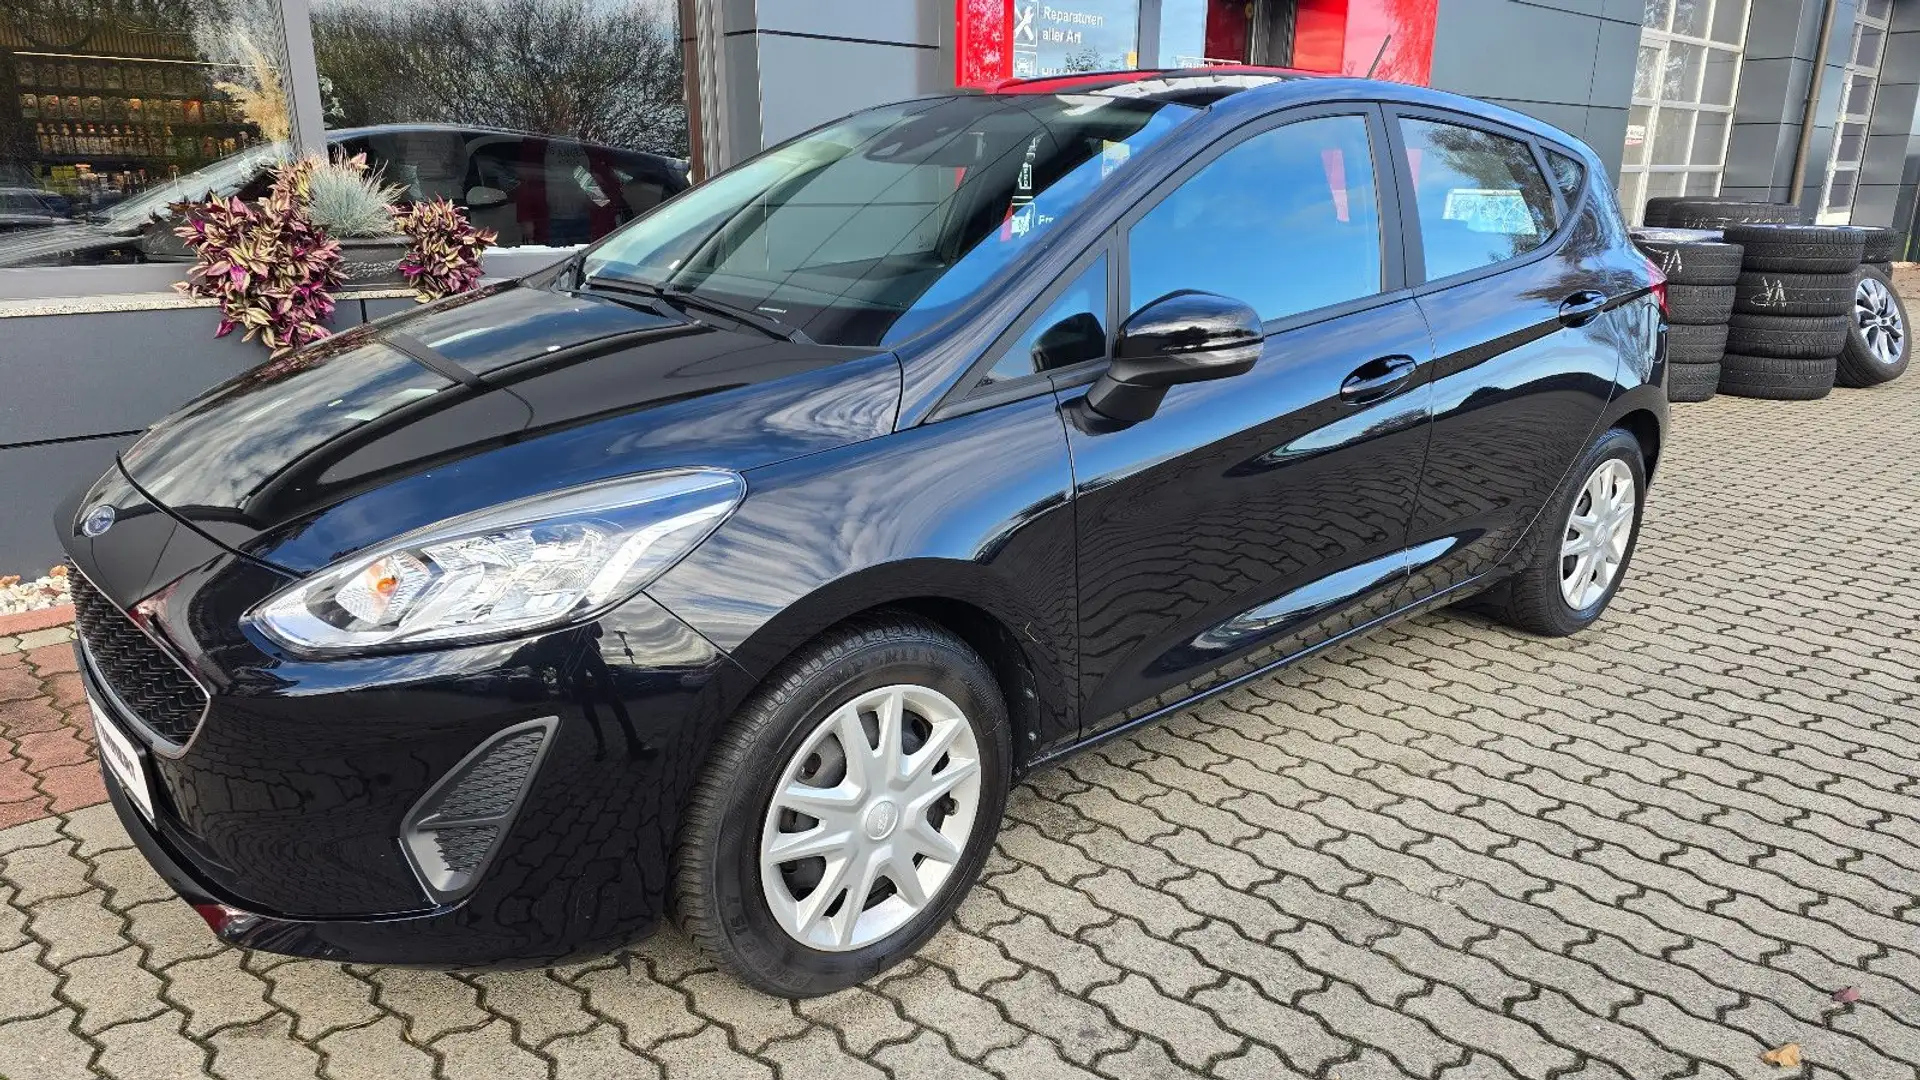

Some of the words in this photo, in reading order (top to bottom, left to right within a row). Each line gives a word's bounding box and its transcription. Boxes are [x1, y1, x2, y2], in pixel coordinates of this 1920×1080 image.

[1043, 6, 1103, 27] Reparaturen
[1042, 27, 1064, 41] aller
[1066, 29, 1082, 43] Art
